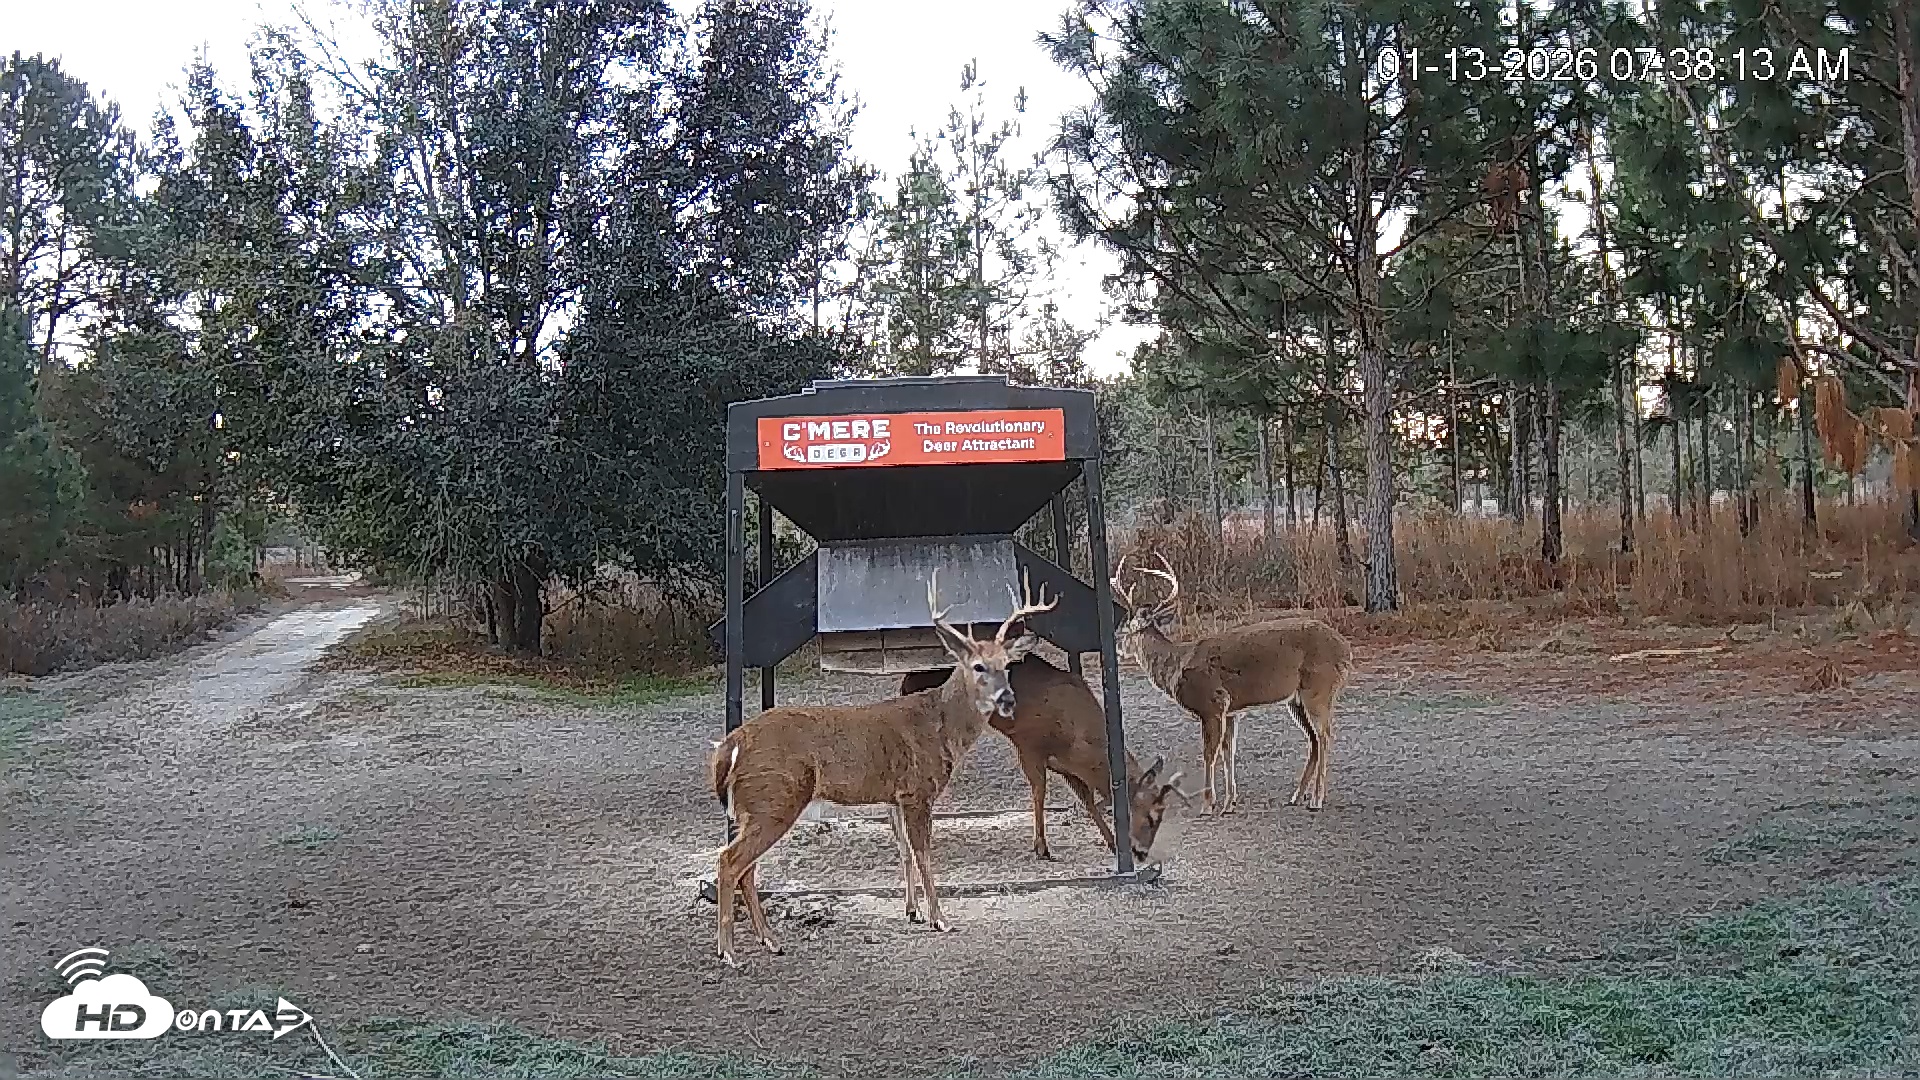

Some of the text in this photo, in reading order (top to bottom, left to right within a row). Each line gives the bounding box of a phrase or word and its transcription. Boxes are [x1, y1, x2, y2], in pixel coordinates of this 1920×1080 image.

[783, 419, 891, 441] C'MERE
[914, 420, 1045, 436] The Revolutionary
[923, 437, 1035, 453] Deer Attractant
